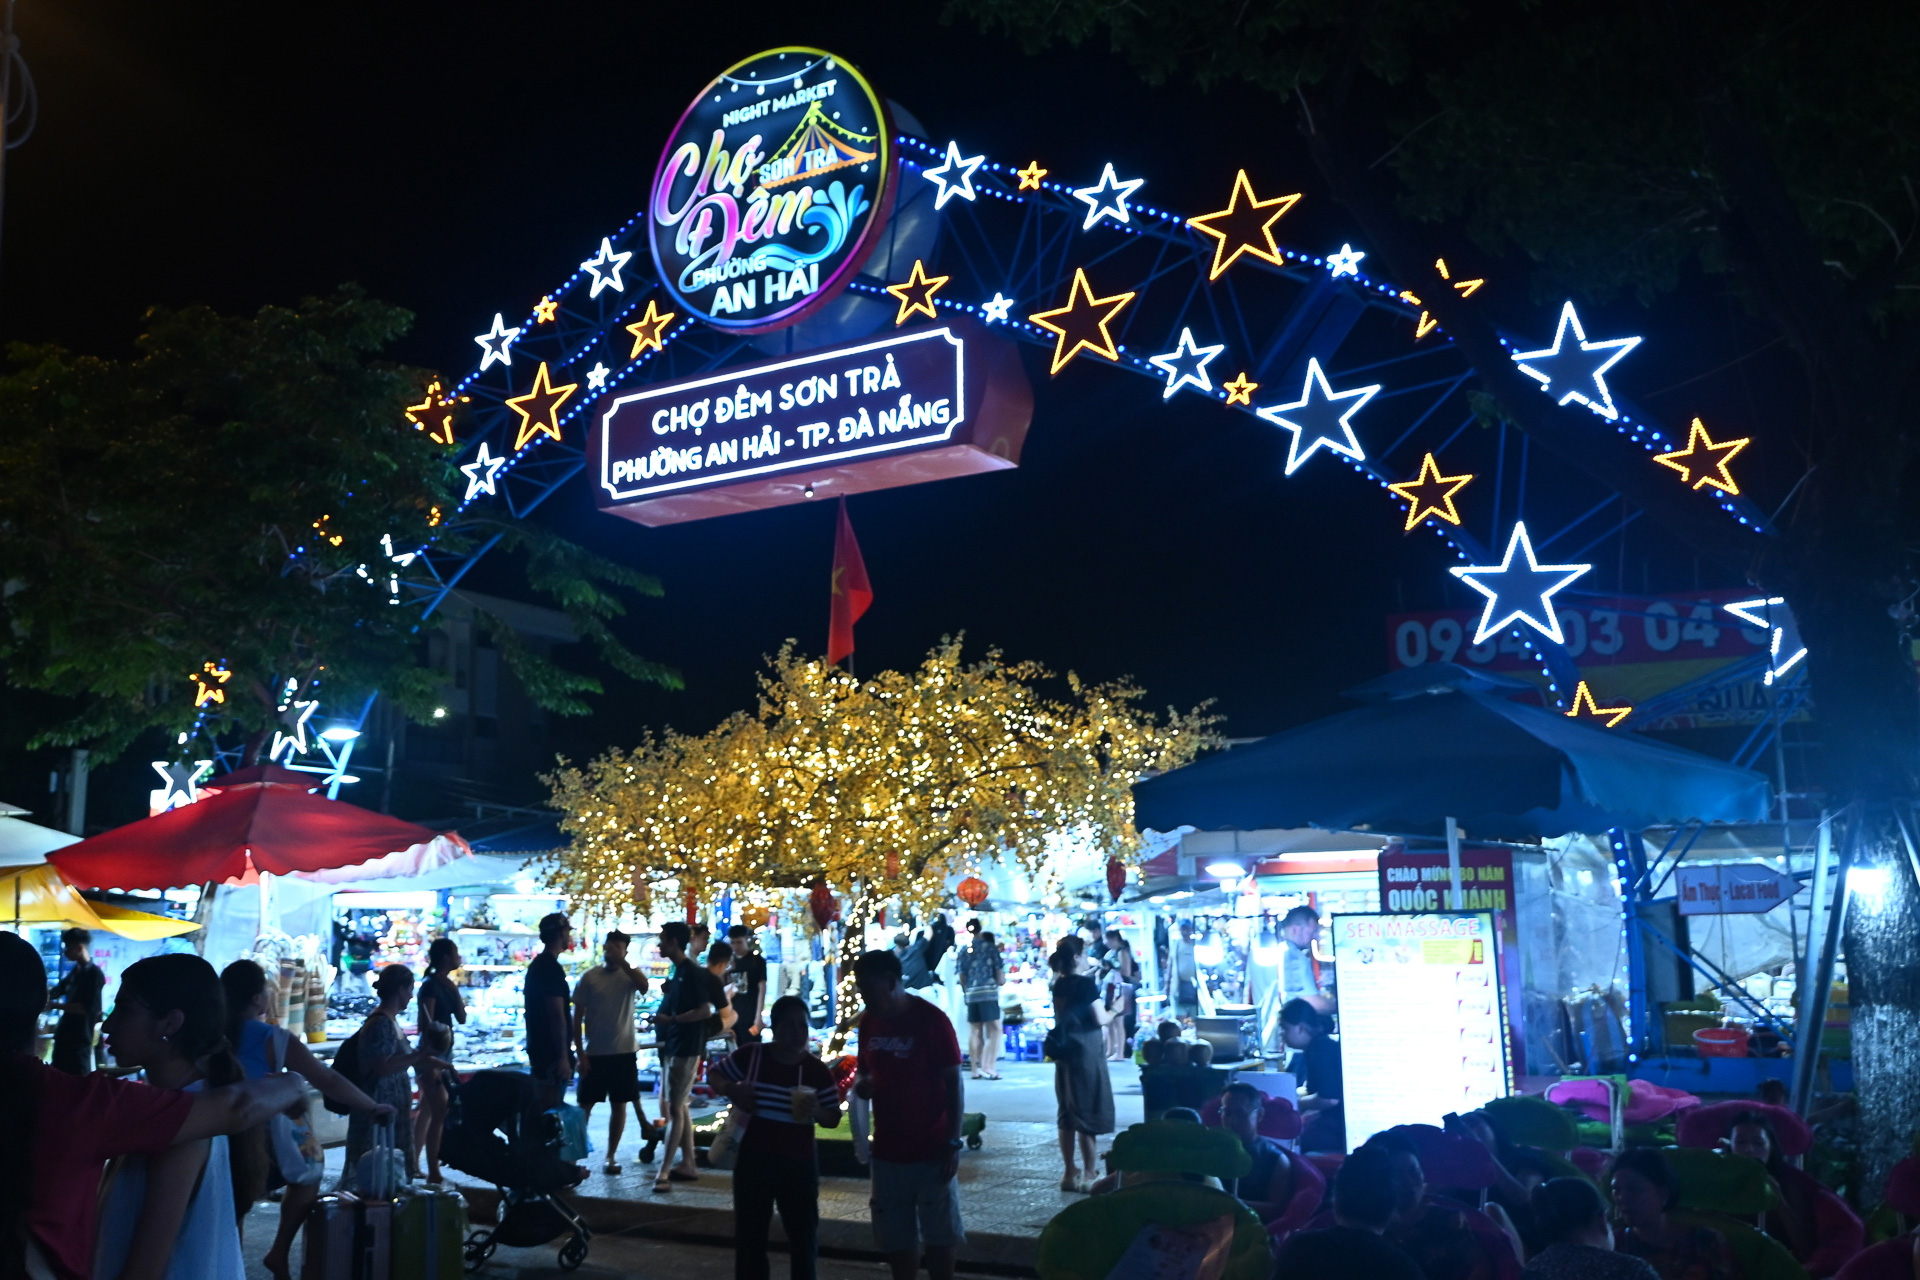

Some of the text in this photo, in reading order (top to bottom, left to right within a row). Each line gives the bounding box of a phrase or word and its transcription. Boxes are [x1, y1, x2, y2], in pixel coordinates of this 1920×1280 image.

[722, 79, 838, 128] NIGHT MARKET
[655, 128, 765, 226] Chợ
[675, 186, 814, 272] Đêm
[709, 258, 820, 317] AN HẢI
[651, 353, 901, 436] CHỢ ĐÊM SƠN TRÀ
[612, 445, 702, 485] PHƯỜNG
[704, 437, 739, 469] AN
[742, 424, 781, 461] HẢI
[836, 411, 875, 443] ĐÀ
[1387, 866, 1418, 882] CHÀO
[1388, 883, 1438, 911] QUỐC
[1347, 922, 1381, 939] SEN
[1387, 918, 1480, 938] MASSAGE
